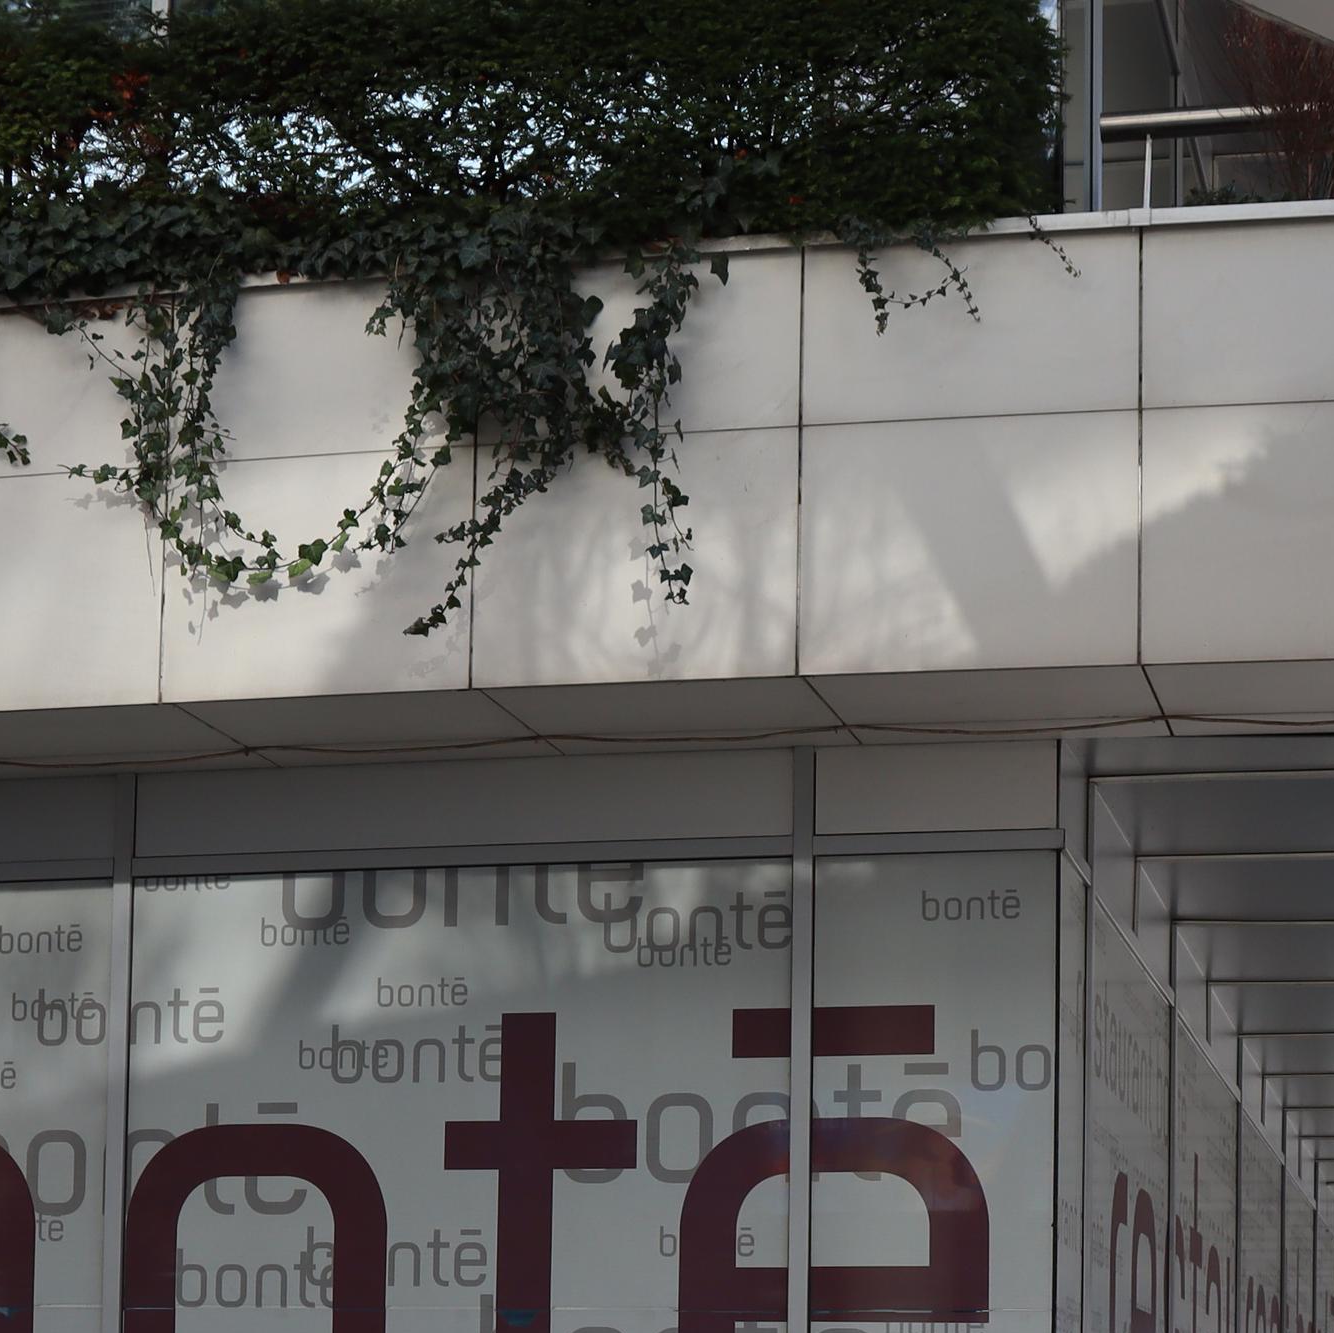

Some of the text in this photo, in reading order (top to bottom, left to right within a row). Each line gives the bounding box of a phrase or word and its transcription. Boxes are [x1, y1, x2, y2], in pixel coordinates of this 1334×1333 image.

[921, 889, 1021, 921] bontē
[377, 976, 468, 1007] bontē
[1076, 969, 1153, 1132] rstaurant
[306, 1226, 488, 1287] bntē
